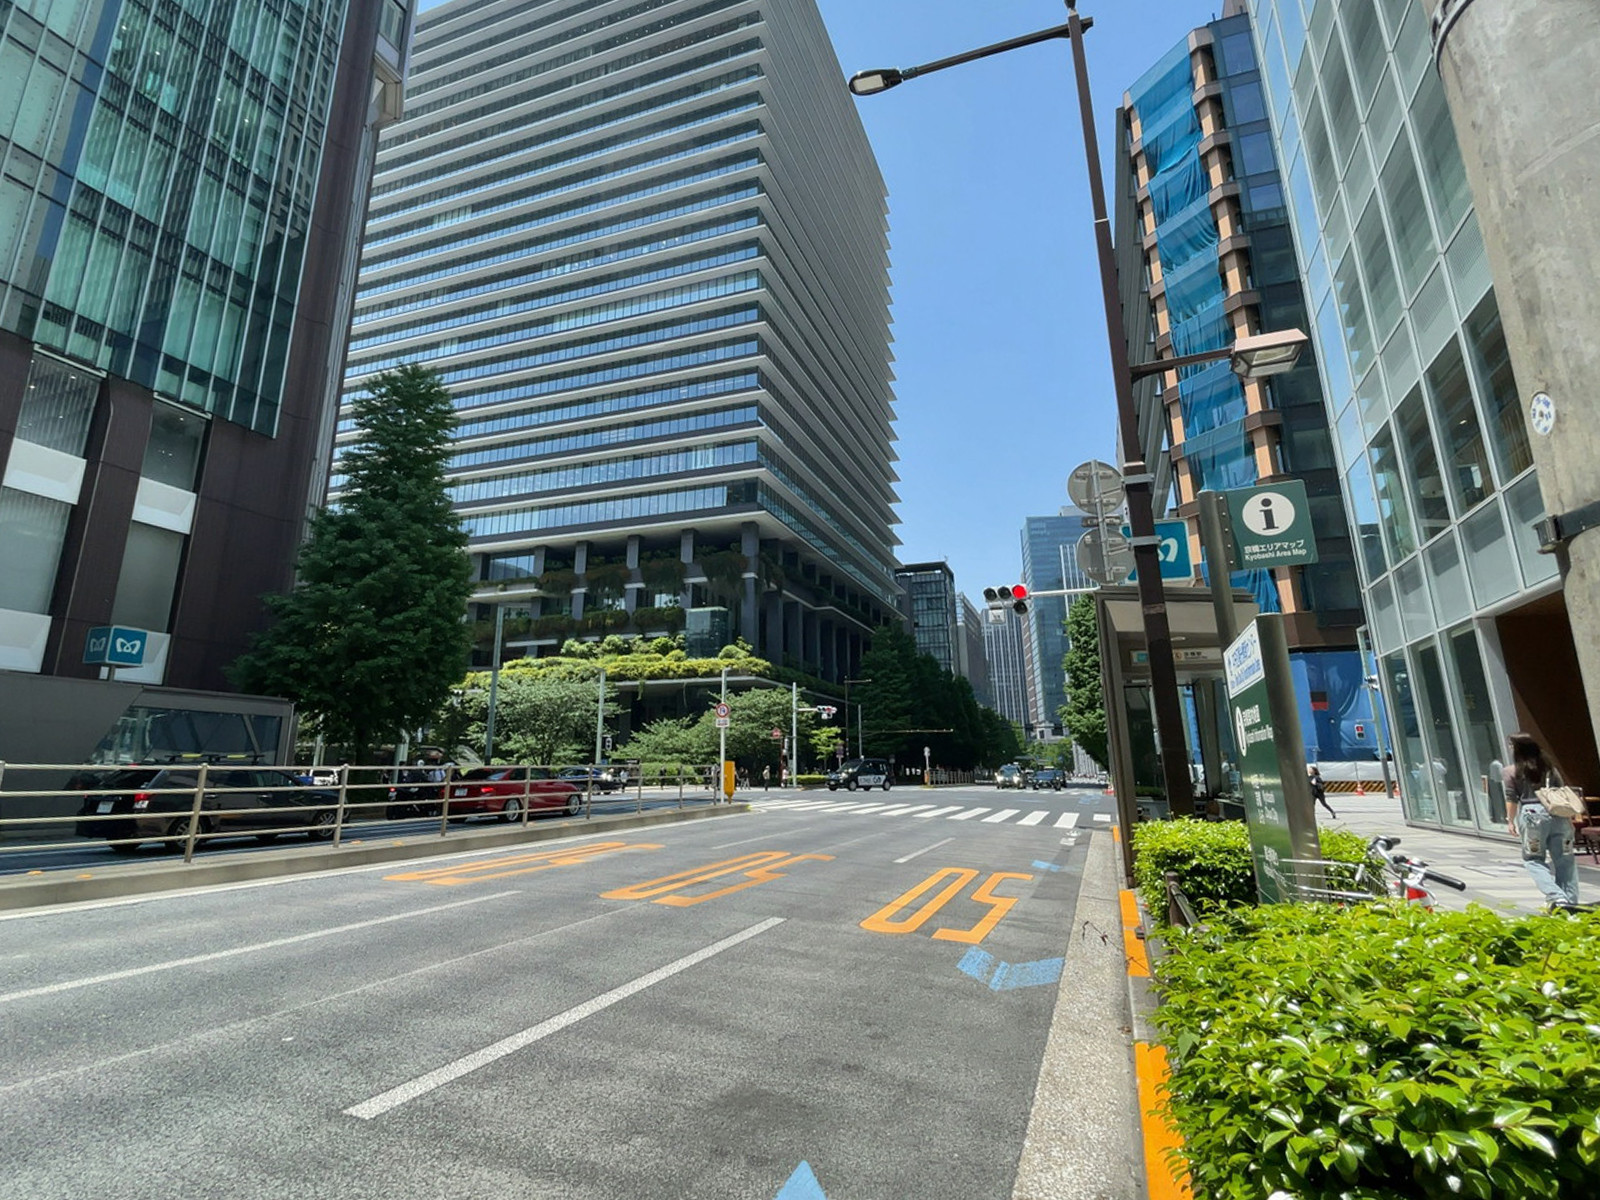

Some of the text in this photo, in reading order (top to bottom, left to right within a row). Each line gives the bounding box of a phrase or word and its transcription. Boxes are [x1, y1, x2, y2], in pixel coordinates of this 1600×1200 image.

[1245, 548, 1307, 561] Kyobashi Area Map
[859, 867, 1034, 944] 50
